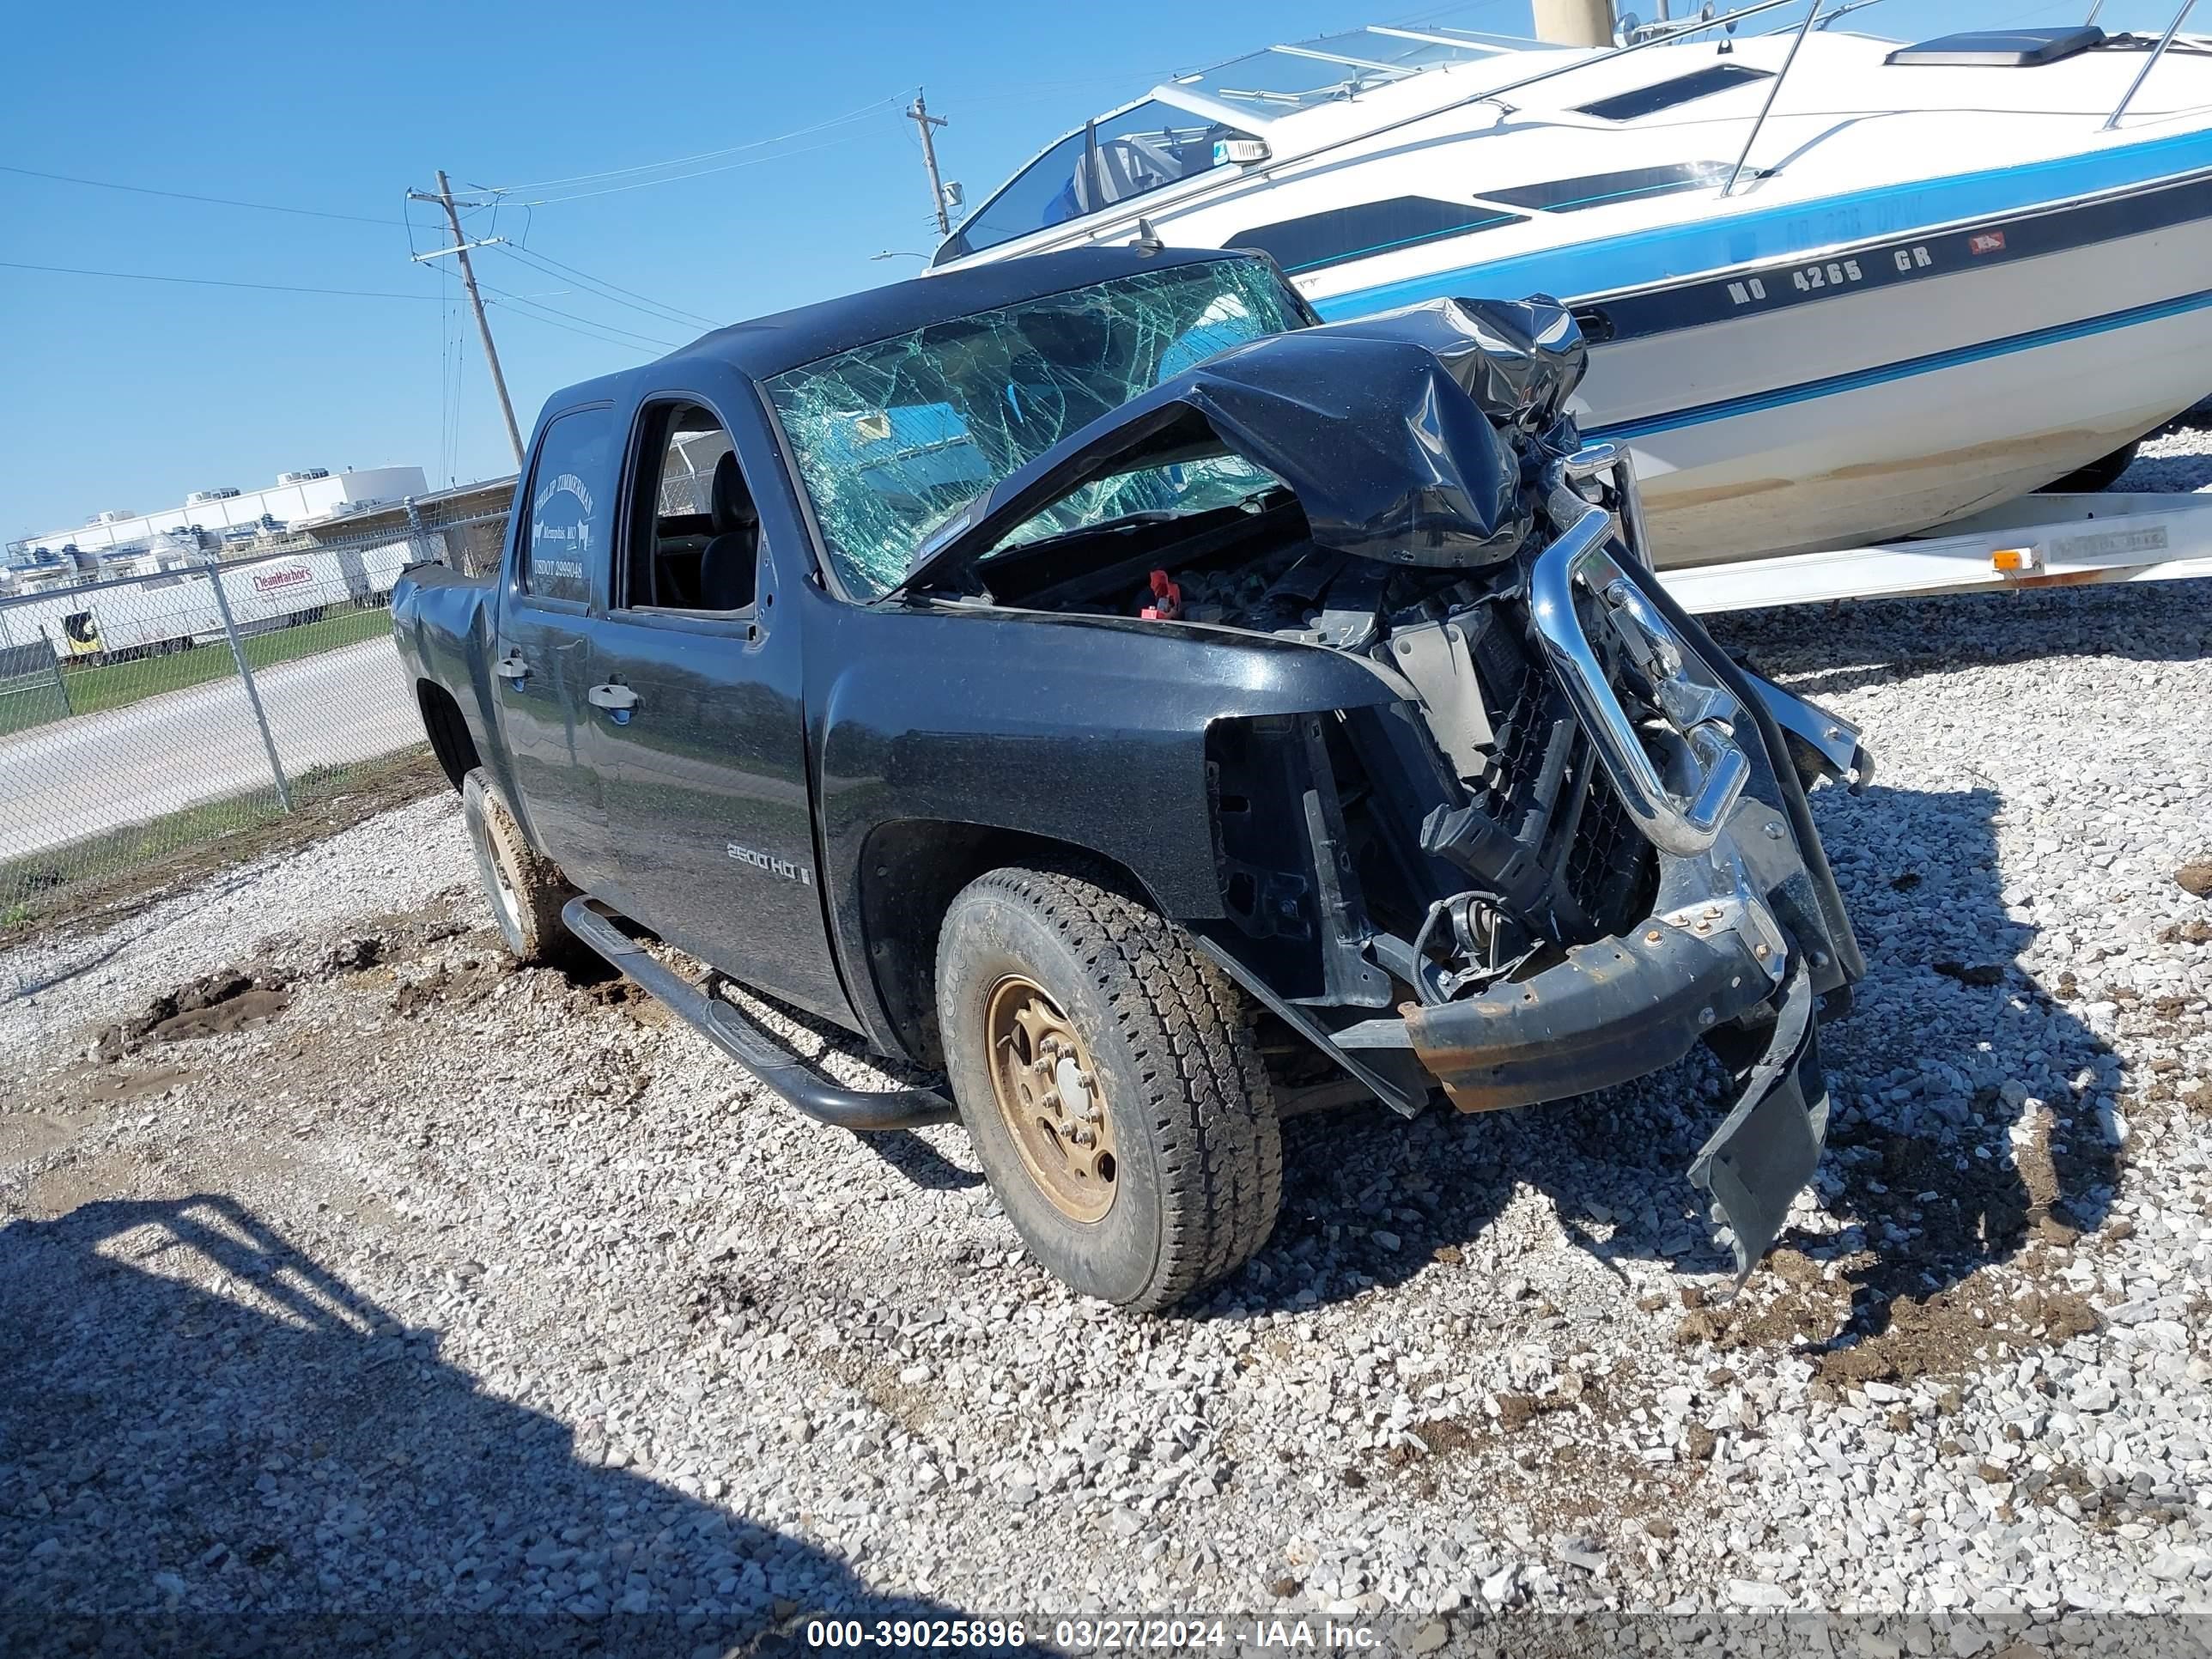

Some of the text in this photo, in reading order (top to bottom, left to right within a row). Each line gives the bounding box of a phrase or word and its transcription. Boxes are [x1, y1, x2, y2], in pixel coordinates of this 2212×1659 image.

[1728, 246, 1933, 305] MO 4265 GR
[535, 473, 594, 518] PHILIP ZIMMERMAN
[544, 526, 577, 543] Memphis, MO
[534, 559, 583, 580] USDOT 2999048
[726, 842, 770, 871] 2500
[770, 856, 796, 879] HD
